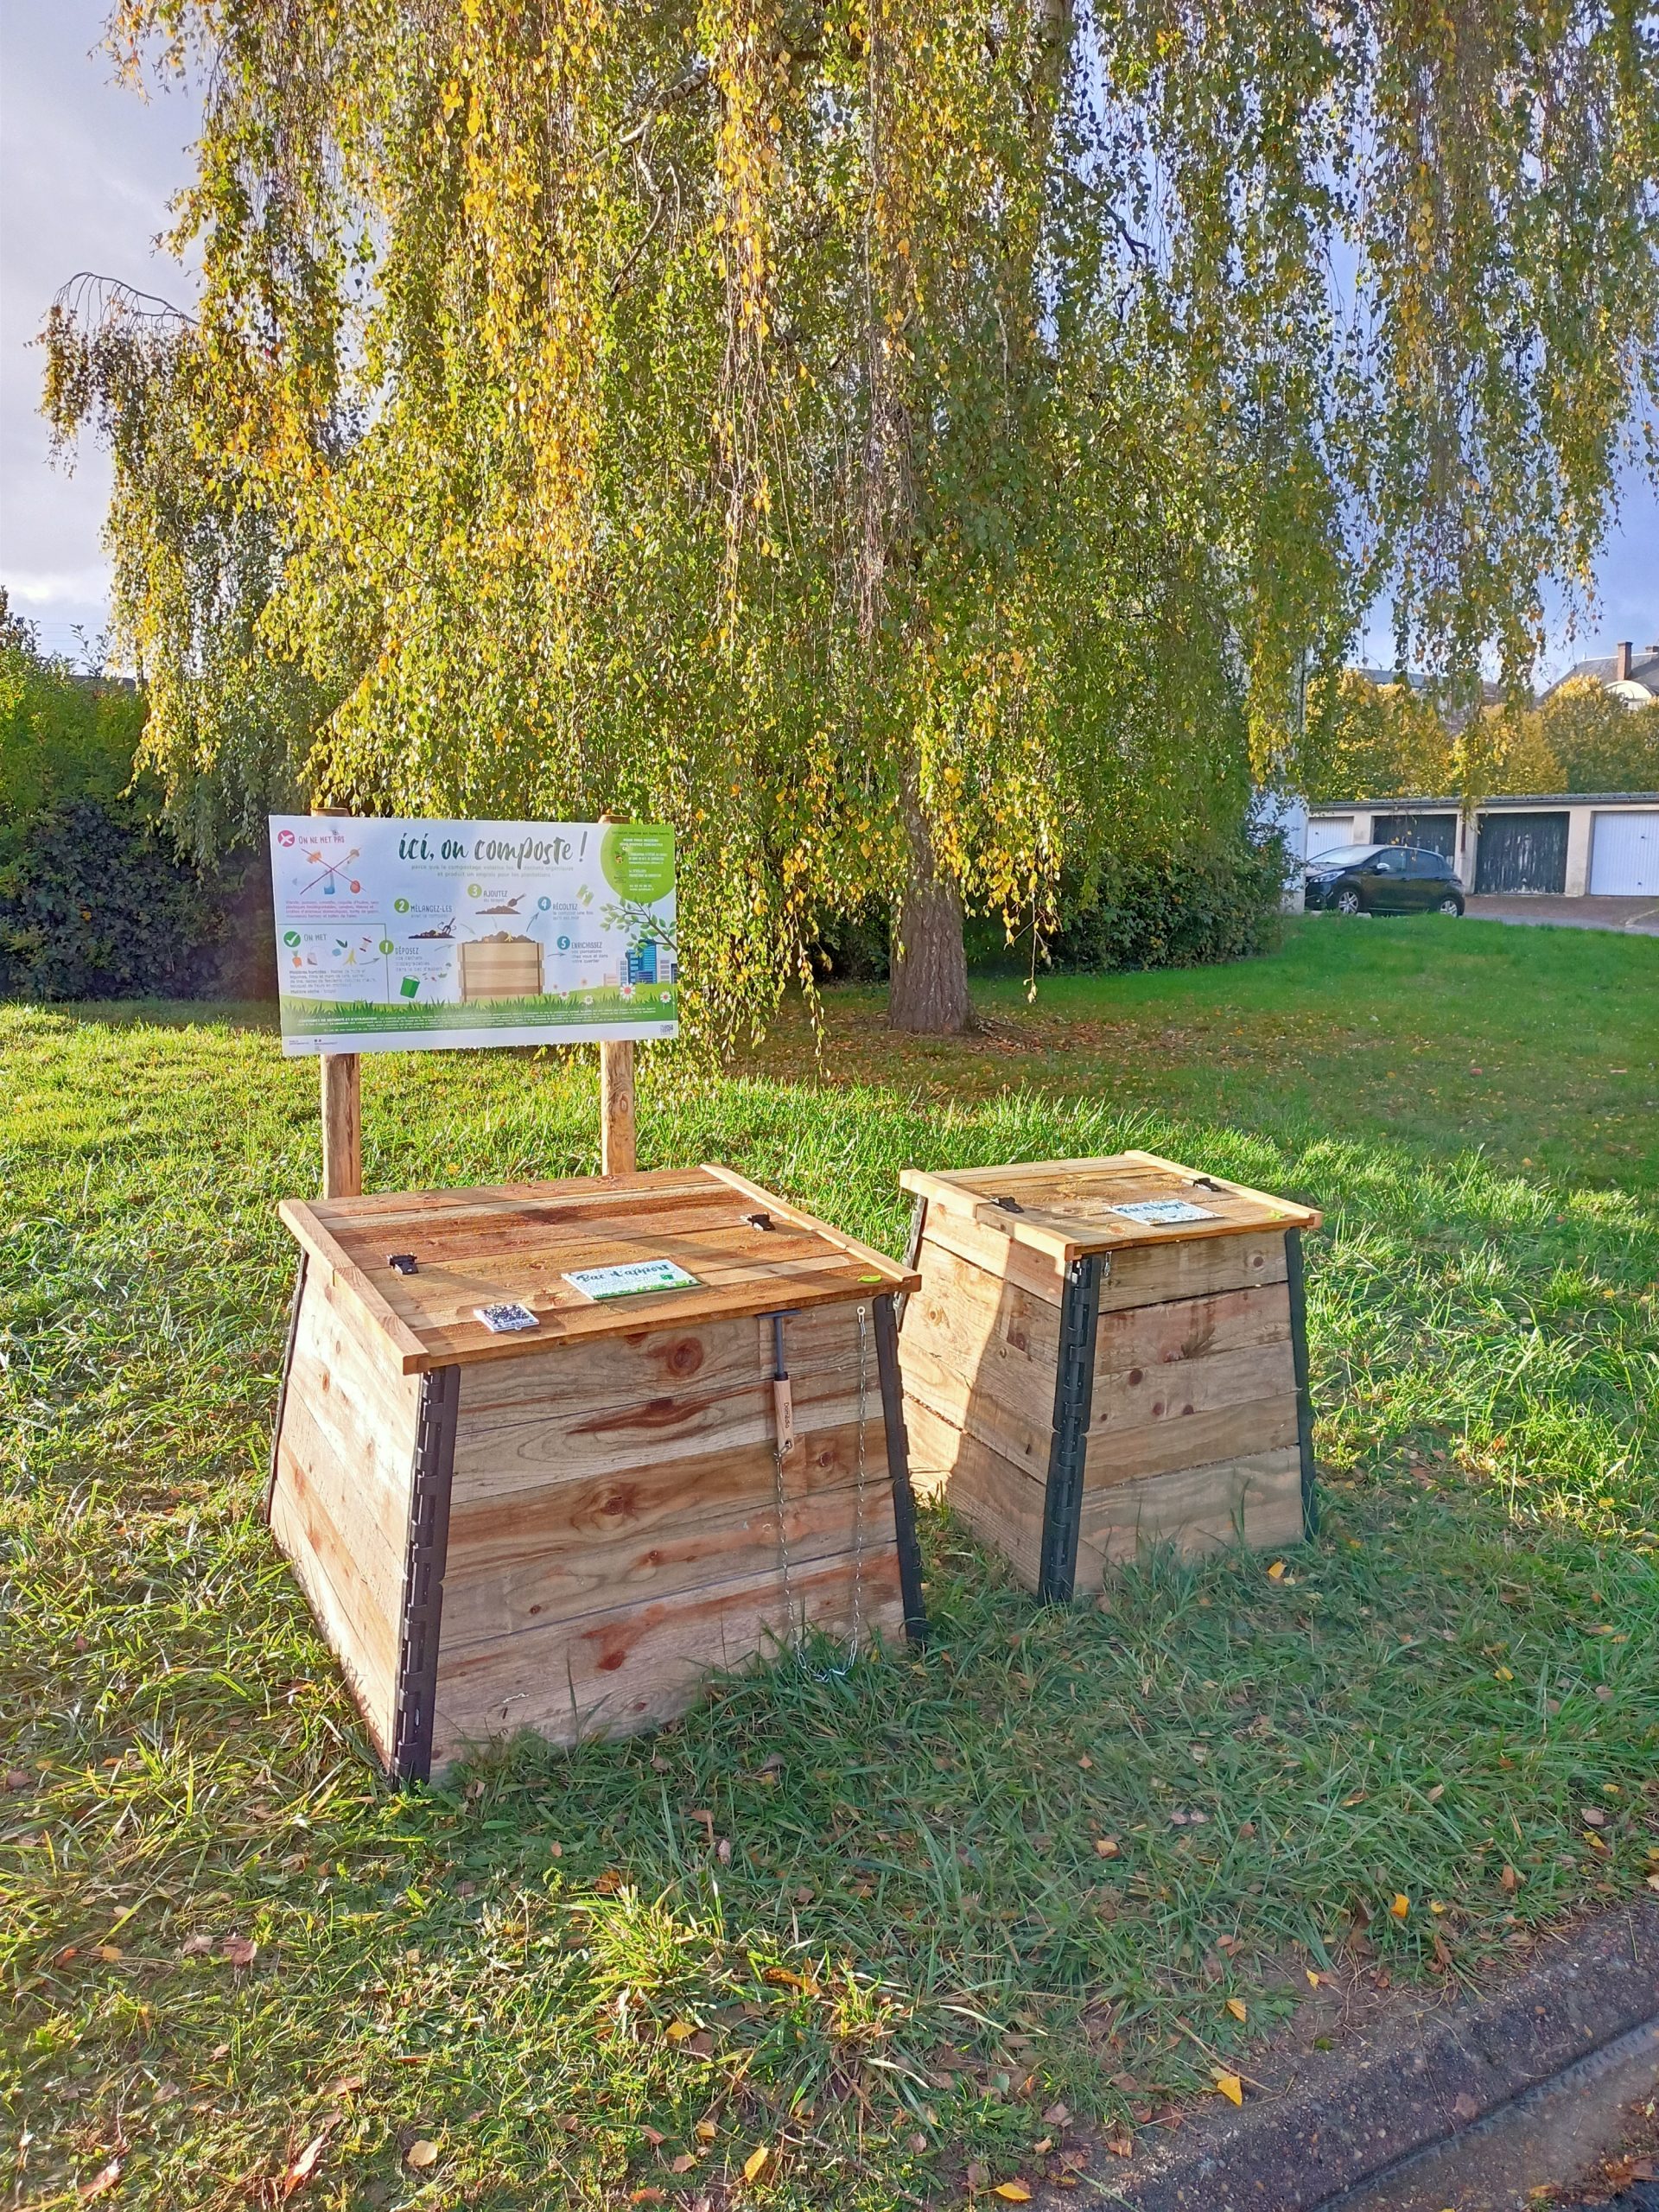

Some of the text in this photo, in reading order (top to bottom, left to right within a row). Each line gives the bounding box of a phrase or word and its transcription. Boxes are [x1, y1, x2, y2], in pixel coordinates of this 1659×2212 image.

[298, 836, 308, 844] ON
[309, 836, 318, 844] NE
[398, 831, 588, 870] ici, on composte !
[472, 886, 478, 896] 3
[398, 900, 453, 912] 2 MÉLANGEZ-LES
[541, 899, 578, 911] 4 RÉCOLTEZ
[303, 933, 313, 942] ON
[561, 938, 567, 948] 5
[395, 945, 419, 955] DÉPOSEZ
[610, 1264, 670, 1277] d'apport
